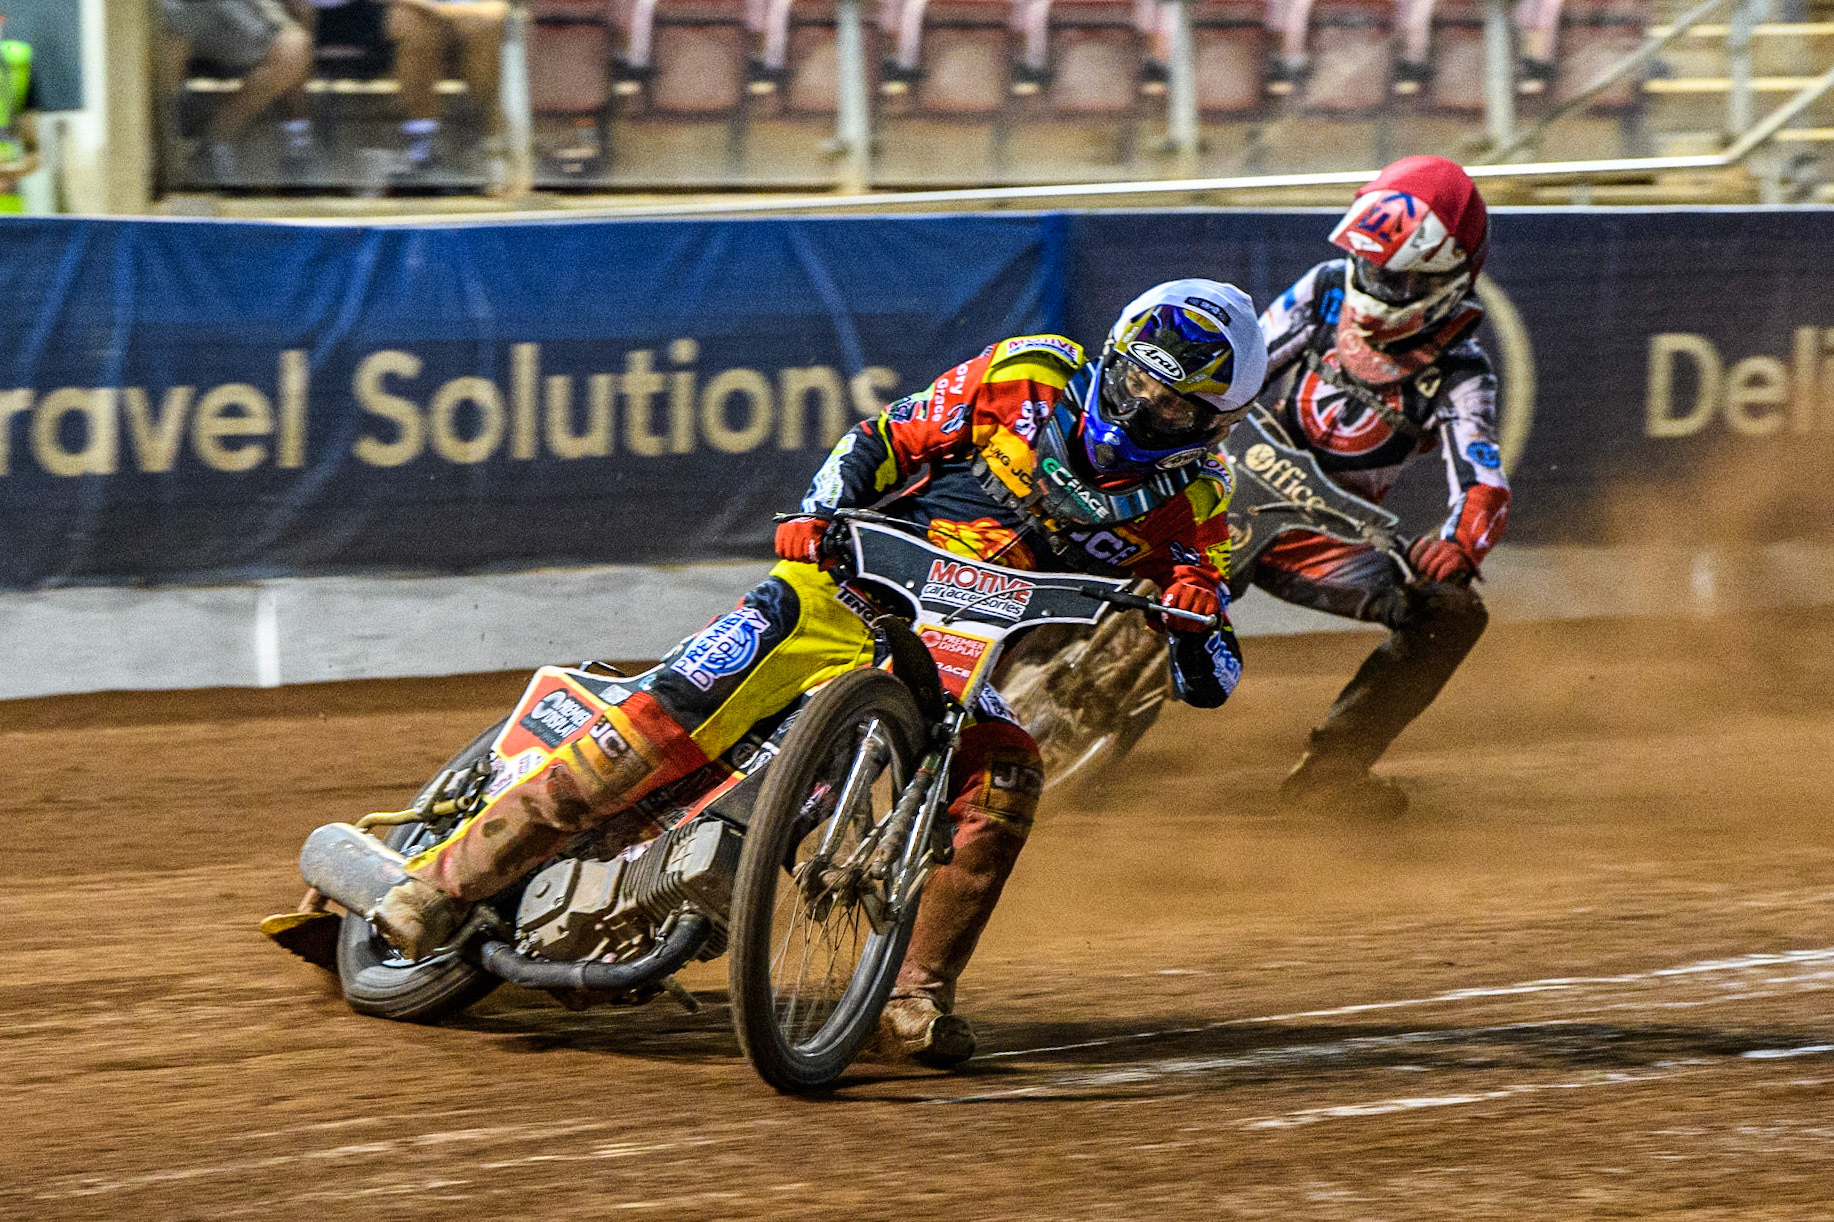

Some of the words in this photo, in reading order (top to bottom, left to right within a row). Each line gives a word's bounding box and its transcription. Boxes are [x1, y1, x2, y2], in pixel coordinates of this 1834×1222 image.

[352, 338, 899, 466] Solutions
[929, 560, 1034, 604] MOTIVE
[675, 606, 754, 673] PREMIER
[689, 610, 770, 689] DISPLAY
[937, 641, 983, 658] DISPLAY
[941, 634, 987, 651] PREMIER
